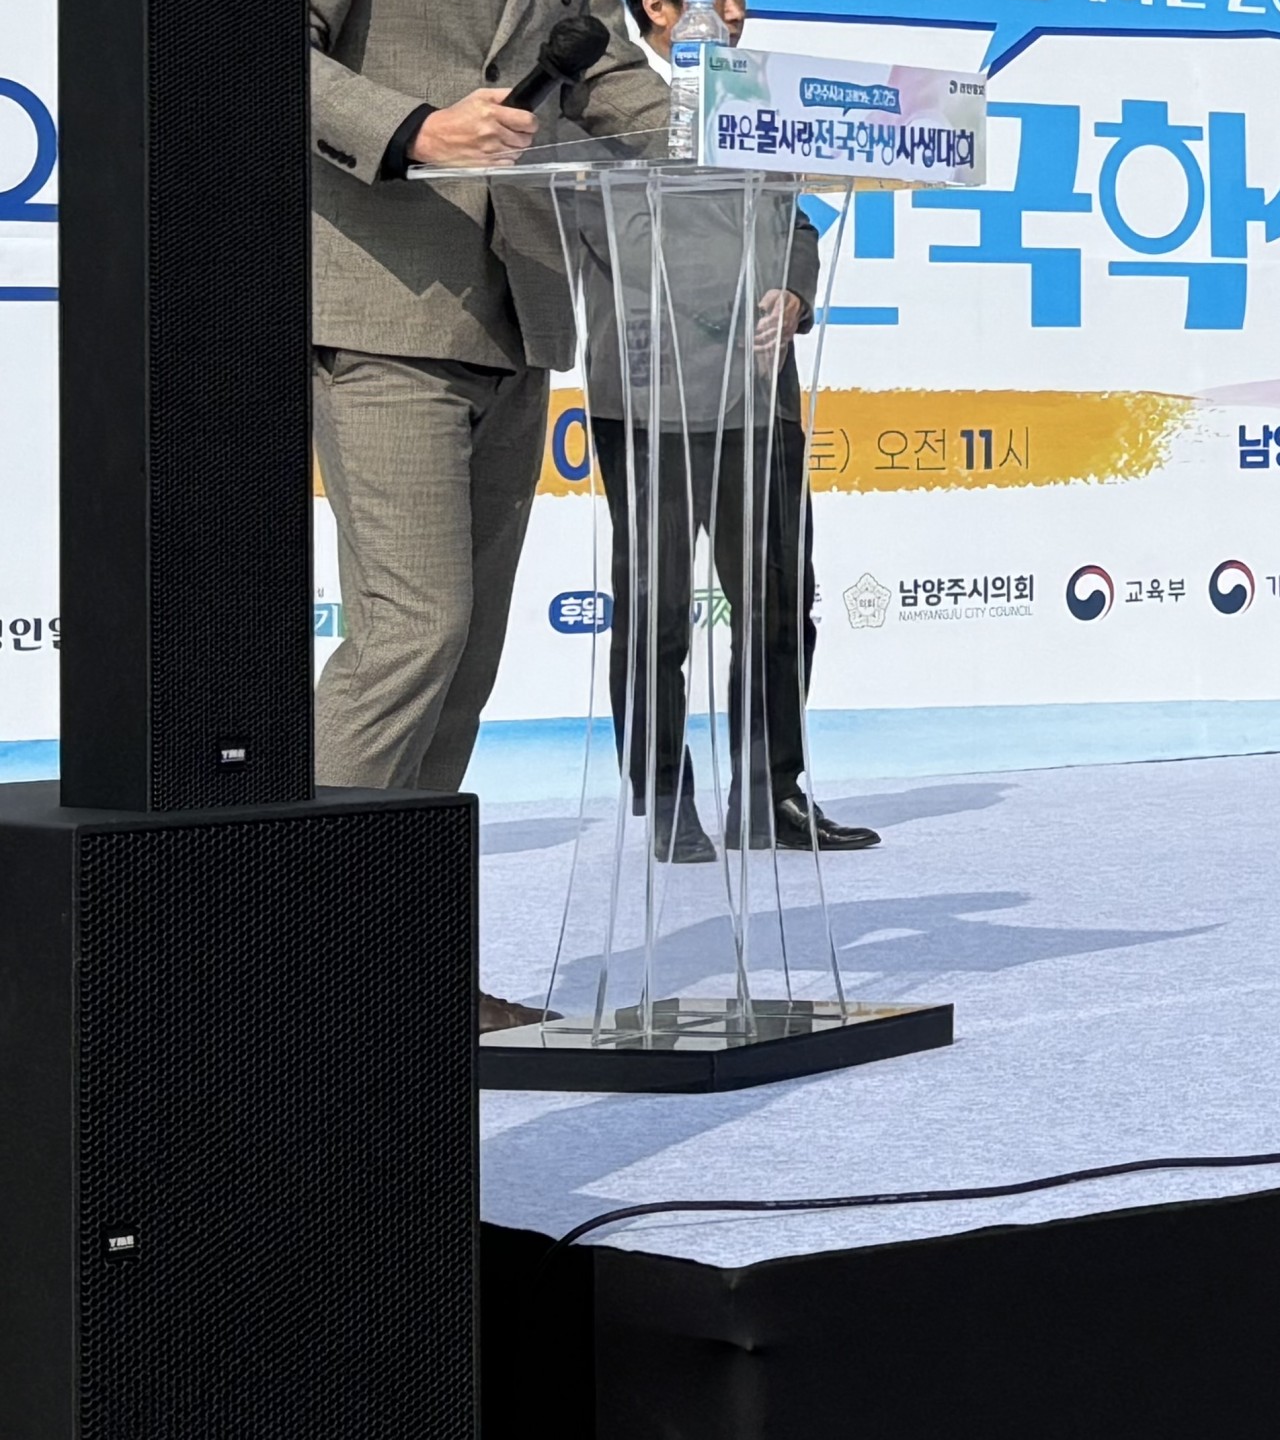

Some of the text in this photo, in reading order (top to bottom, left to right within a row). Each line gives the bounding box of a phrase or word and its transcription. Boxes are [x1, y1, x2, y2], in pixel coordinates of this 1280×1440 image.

[875, 429, 946, 471] 오전
[960, 426, 1030, 471] 11시
[899, 574, 1034, 607] 남양주시의회
[1125, 578, 1186, 603] 교육부
[560, 597, 604, 626] 후원
[965, 607, 987, 618] CITY
